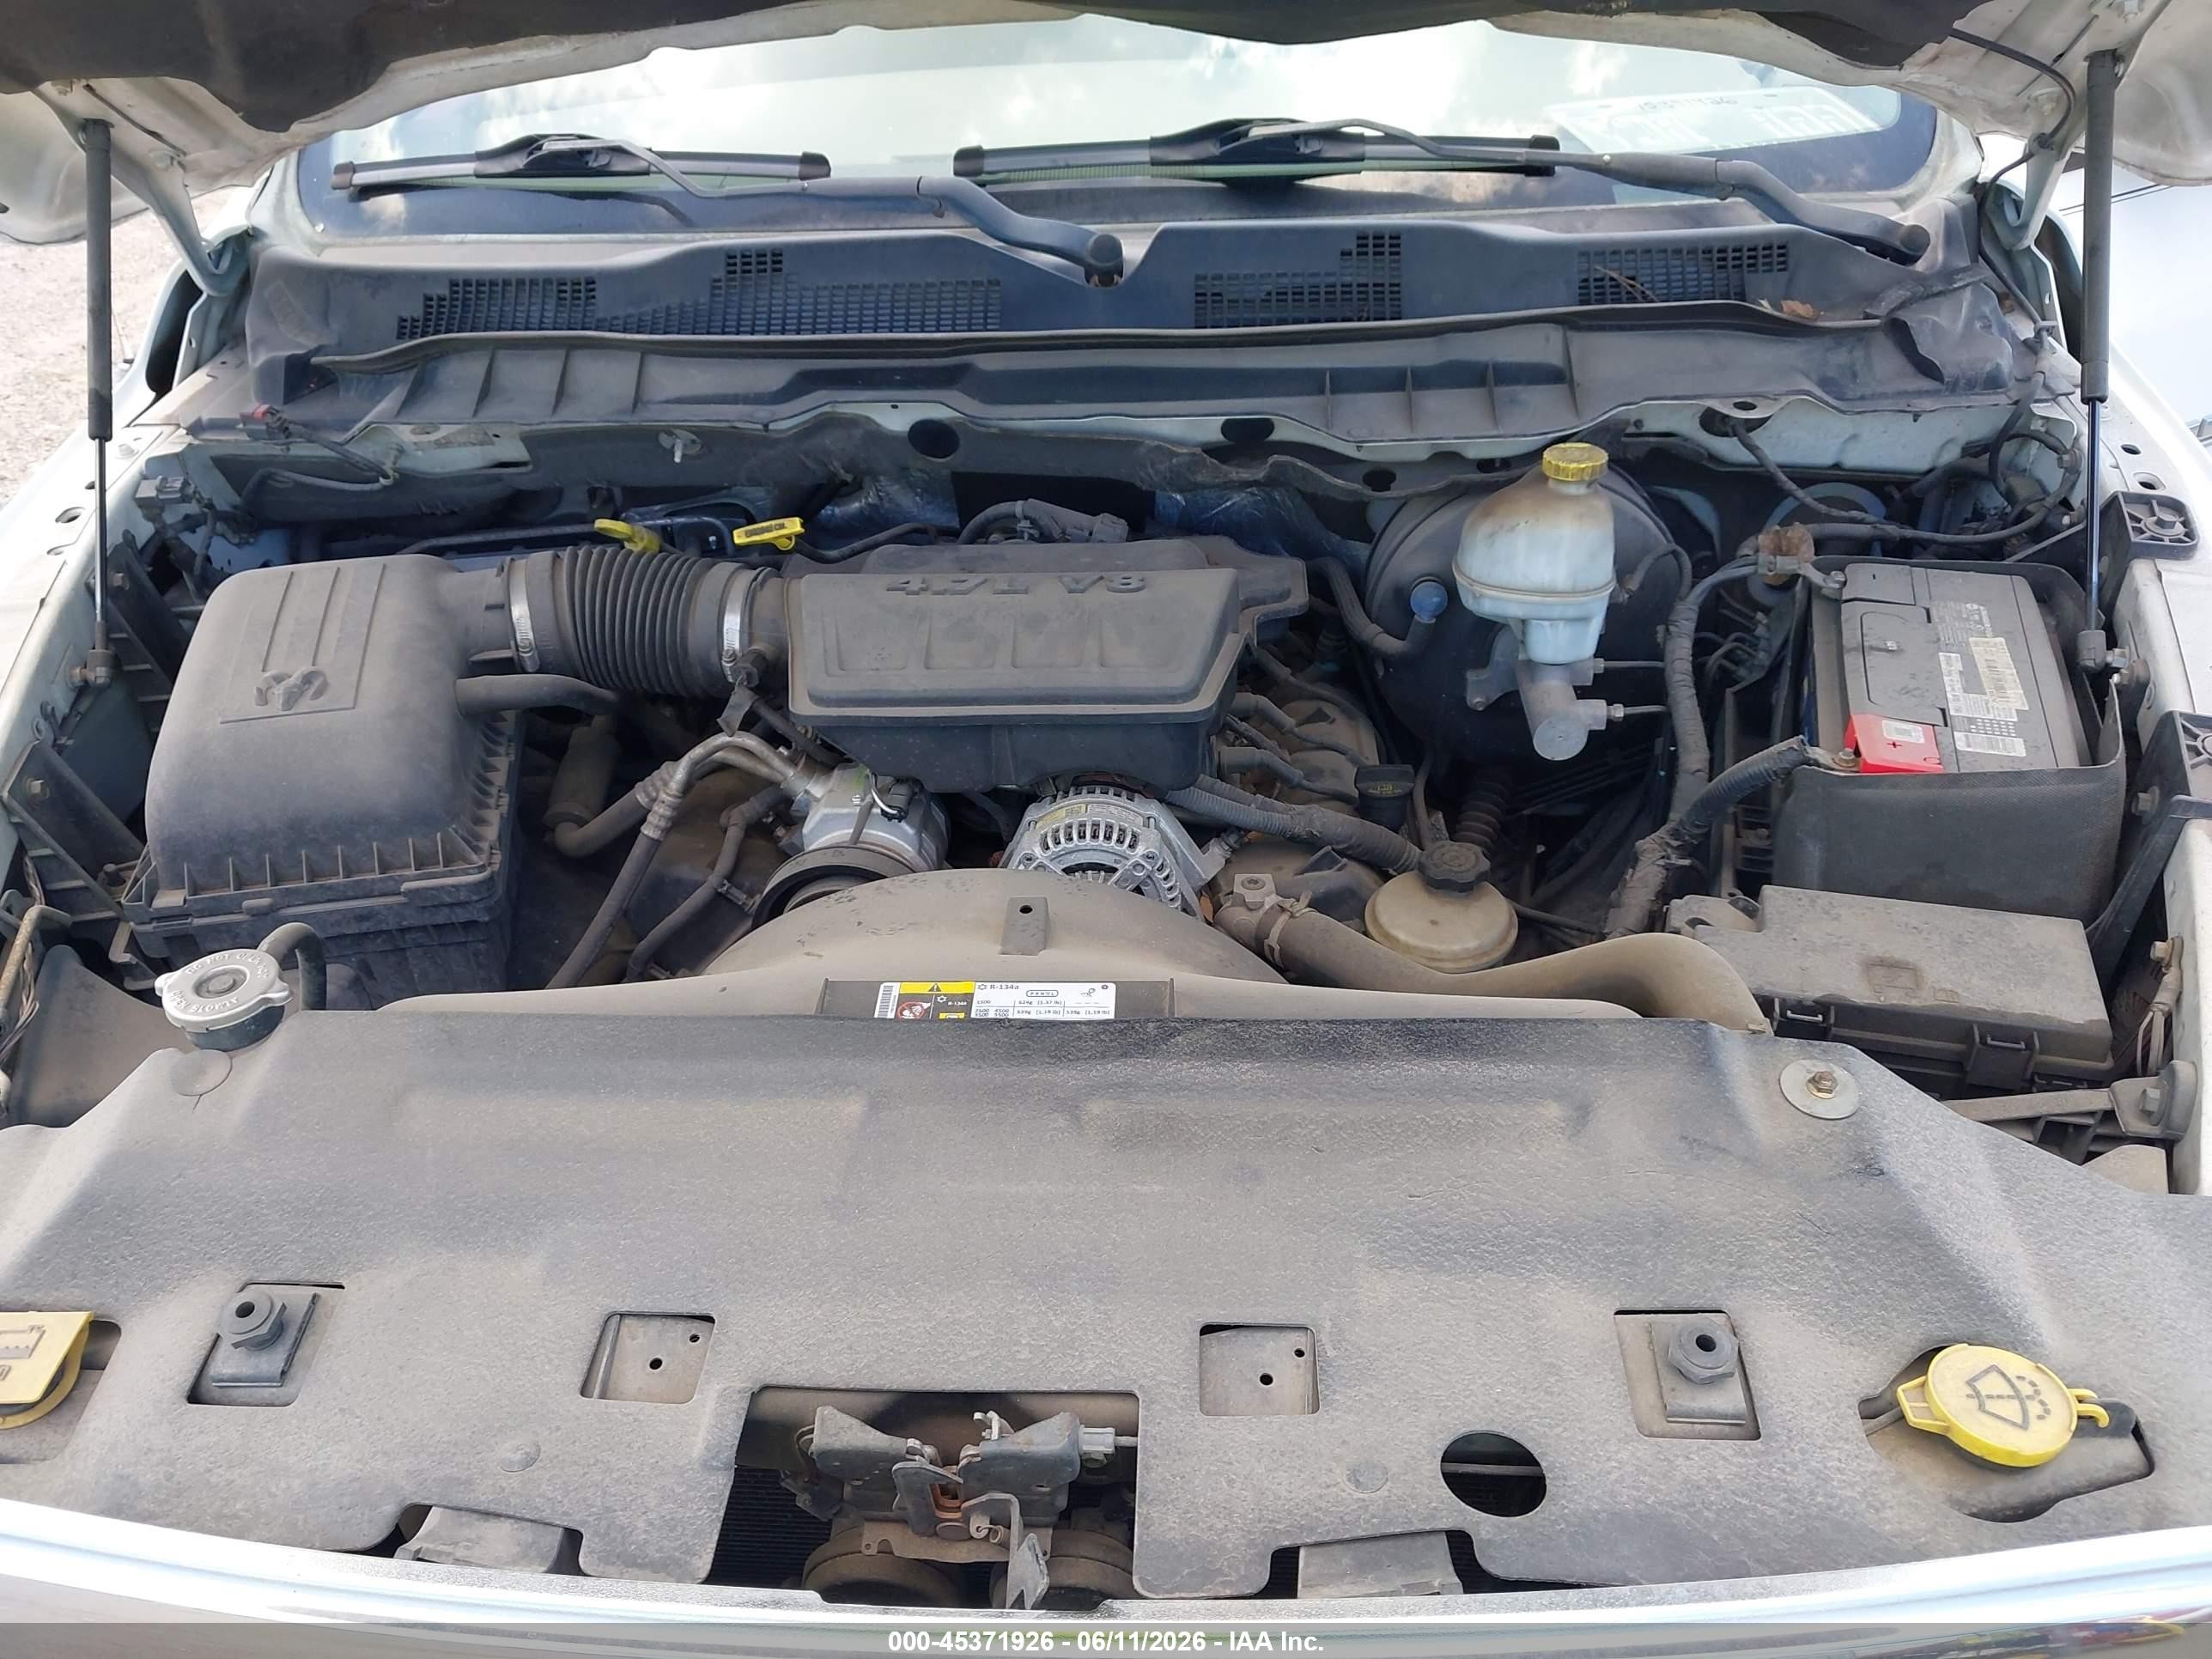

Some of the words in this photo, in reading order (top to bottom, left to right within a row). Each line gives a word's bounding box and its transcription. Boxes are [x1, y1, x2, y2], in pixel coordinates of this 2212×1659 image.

[886, 575, 1029, 596] 4.7L
[1058, 574, 1146, 594] V8
[185, 963, 203, 975] DO
[206, 953, 231, 963] NOT
